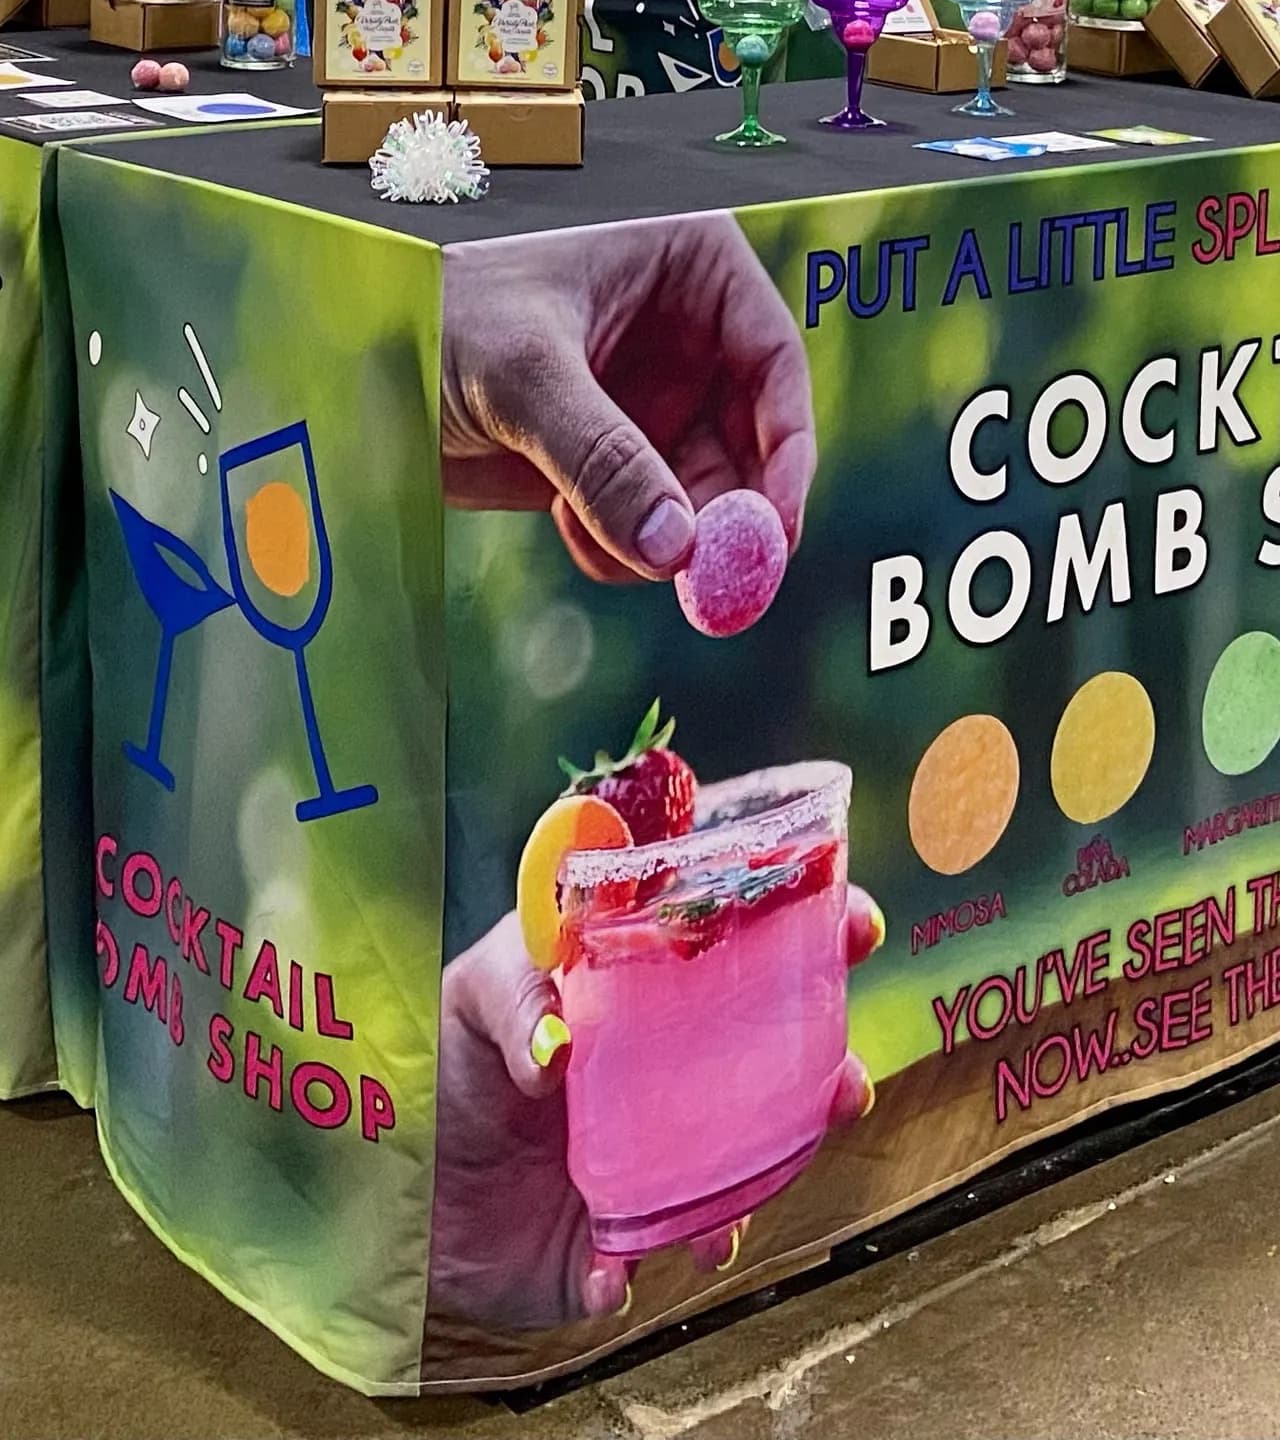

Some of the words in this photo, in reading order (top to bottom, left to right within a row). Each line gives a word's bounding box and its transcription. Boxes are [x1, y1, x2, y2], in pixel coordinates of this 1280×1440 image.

[805, 234, 930, 329] PUT
[941, 228, 992, 306] A
[1007, 200, 1177, 295] LITTLE
[867, 488, 1208, 675] BOMB
[95, 832, 354, 1041] COCKTAIL
[911, 891, 1007, 956] MIMOSA
[1062, 856, 1132, 897] COLADA
[933, 928, 1111, 1056] YOU'VE
[1122, 885, 1236, 979] SEEN
[207, 1013, 396, 1144] SHOP
